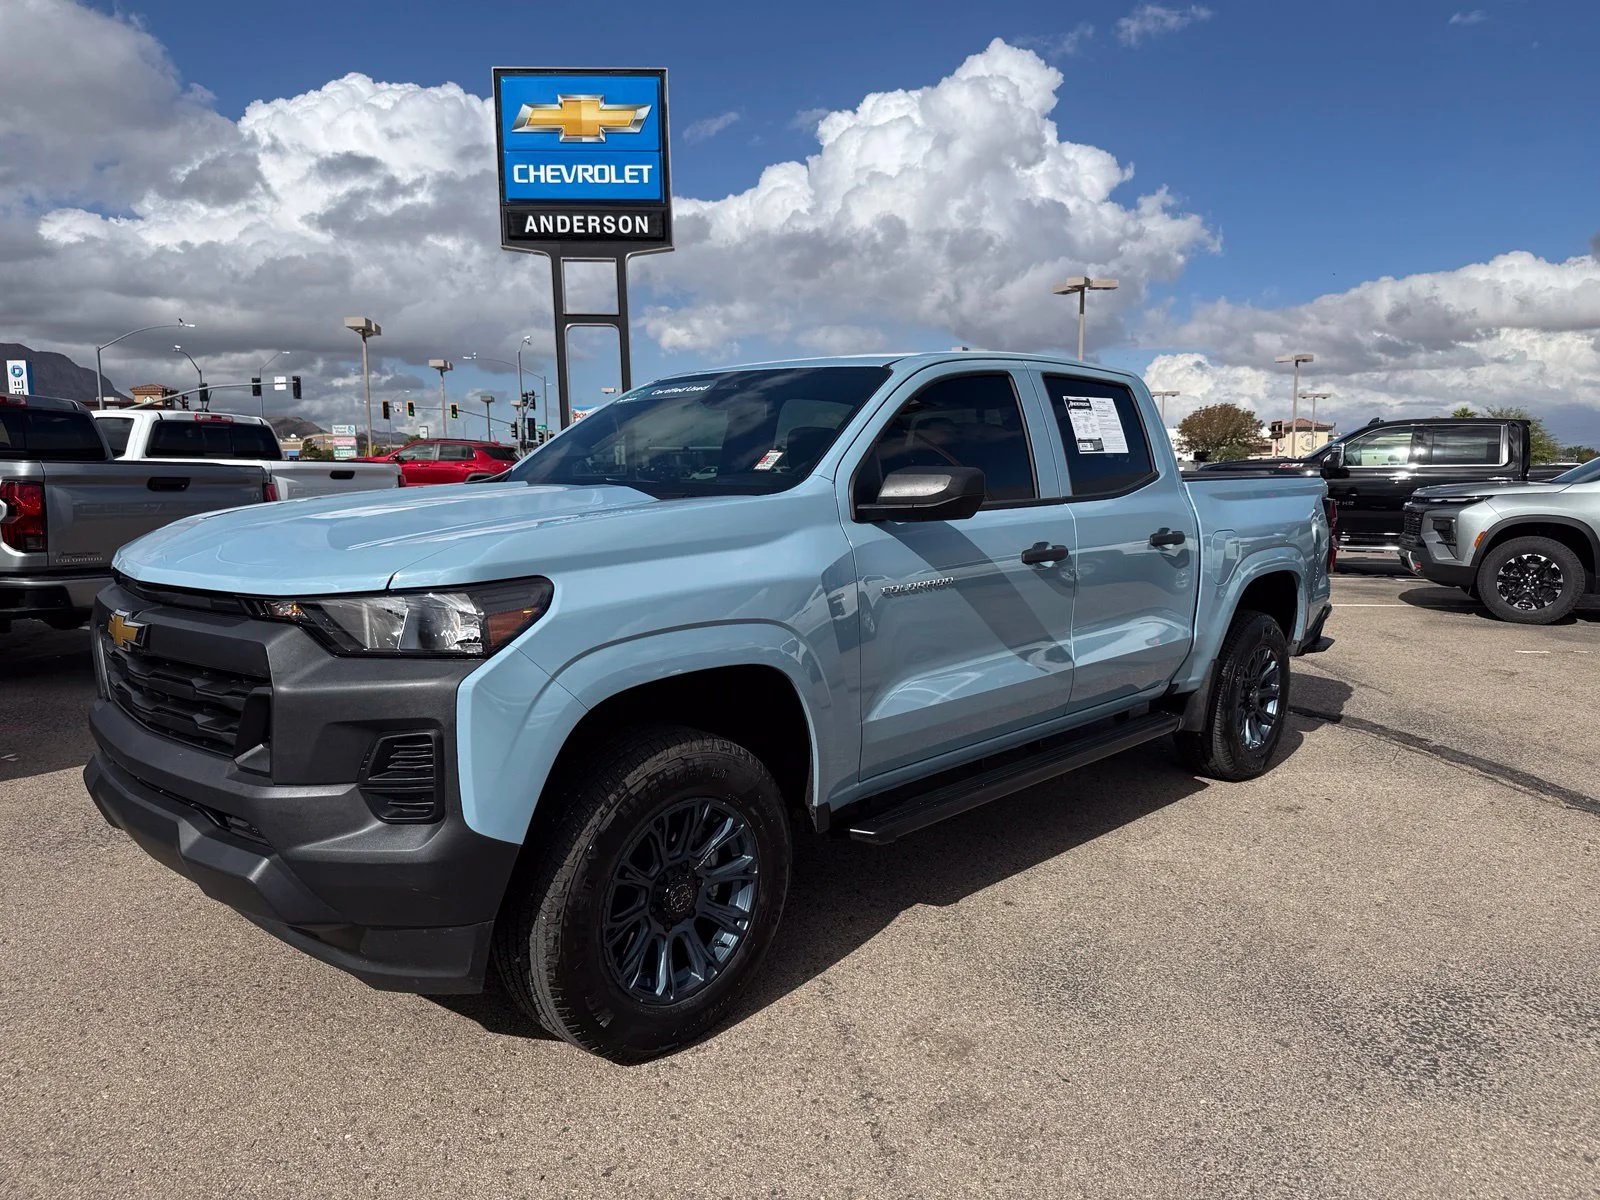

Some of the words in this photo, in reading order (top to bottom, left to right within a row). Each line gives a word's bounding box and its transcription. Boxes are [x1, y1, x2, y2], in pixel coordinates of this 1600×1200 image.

[513, 164, 653, 184] CHEVROLET
[524, 215, 649, 234] ANDERSON
[651, 386, 688, 396] Certified
[686, 384, 711, 393] Used
[880, 576, 955, 594] COLORADO
